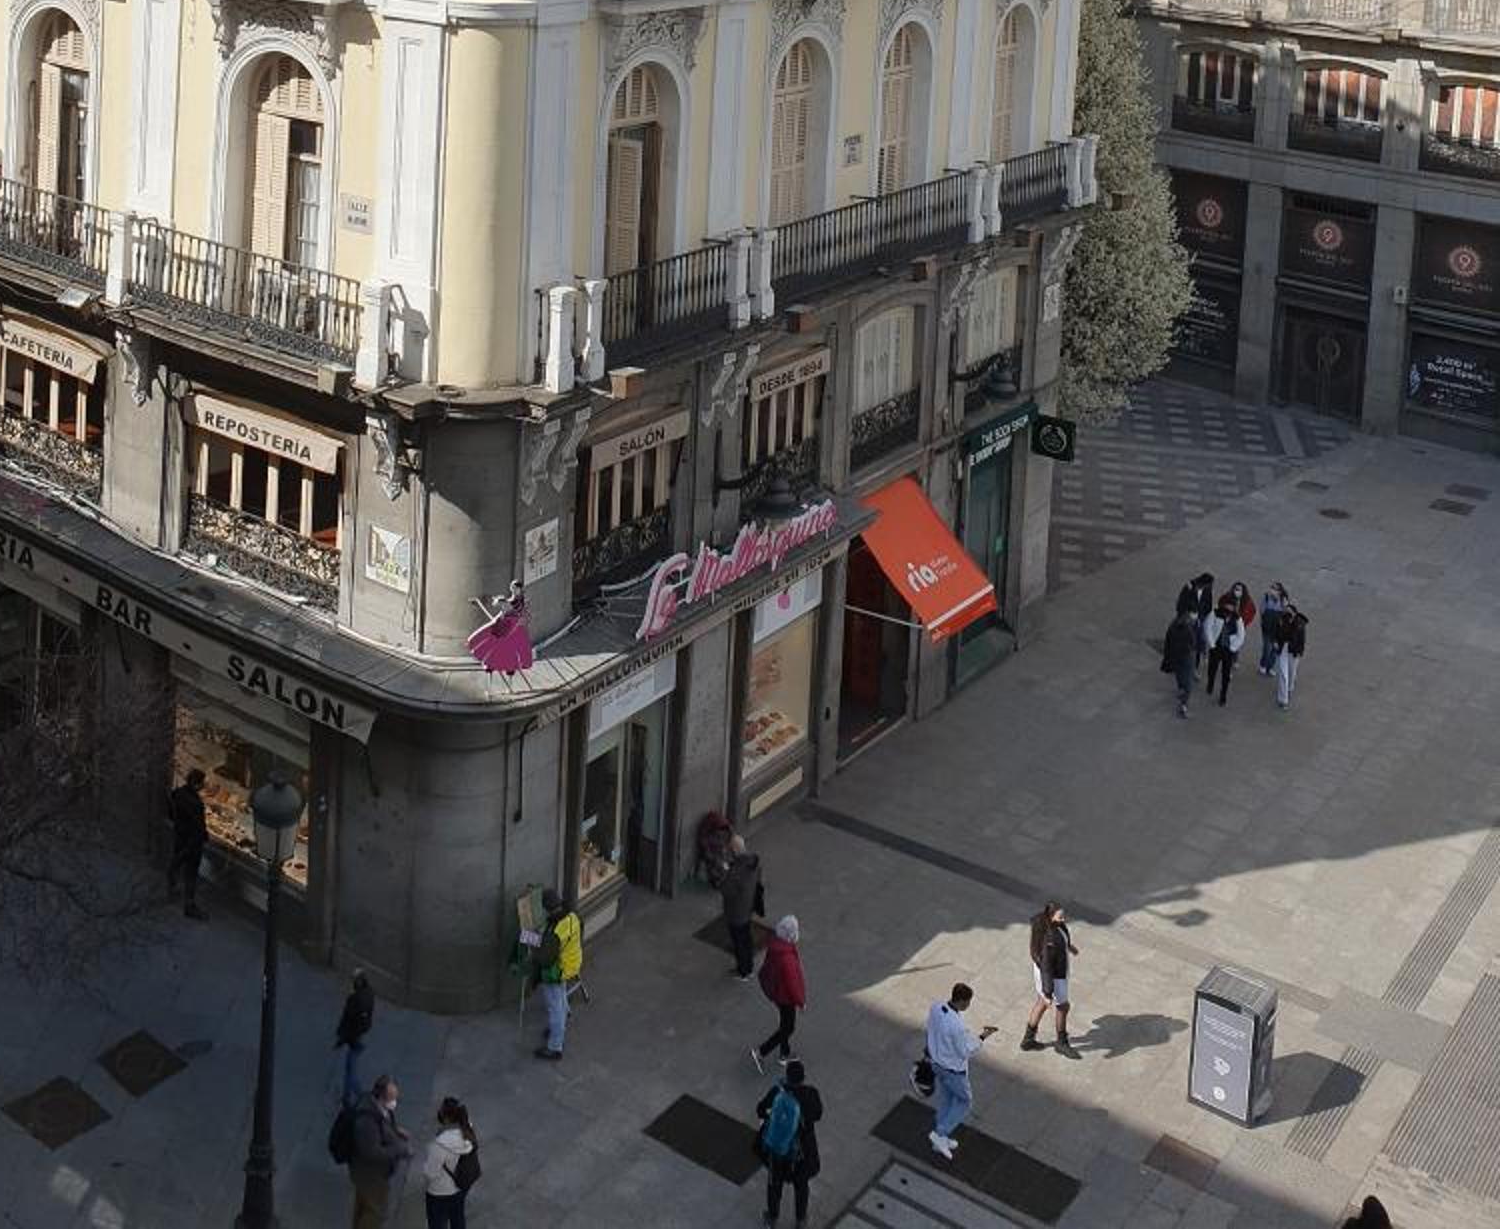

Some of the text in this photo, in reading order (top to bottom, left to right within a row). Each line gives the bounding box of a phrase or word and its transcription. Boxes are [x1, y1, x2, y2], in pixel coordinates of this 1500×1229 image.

[204, 410, 312, 463] REPOSTERÍA
[619, 427, 665, 456] SALÓN
[95, 583, 152, 634] BAR
[227, 654, 346, 730] SALON
